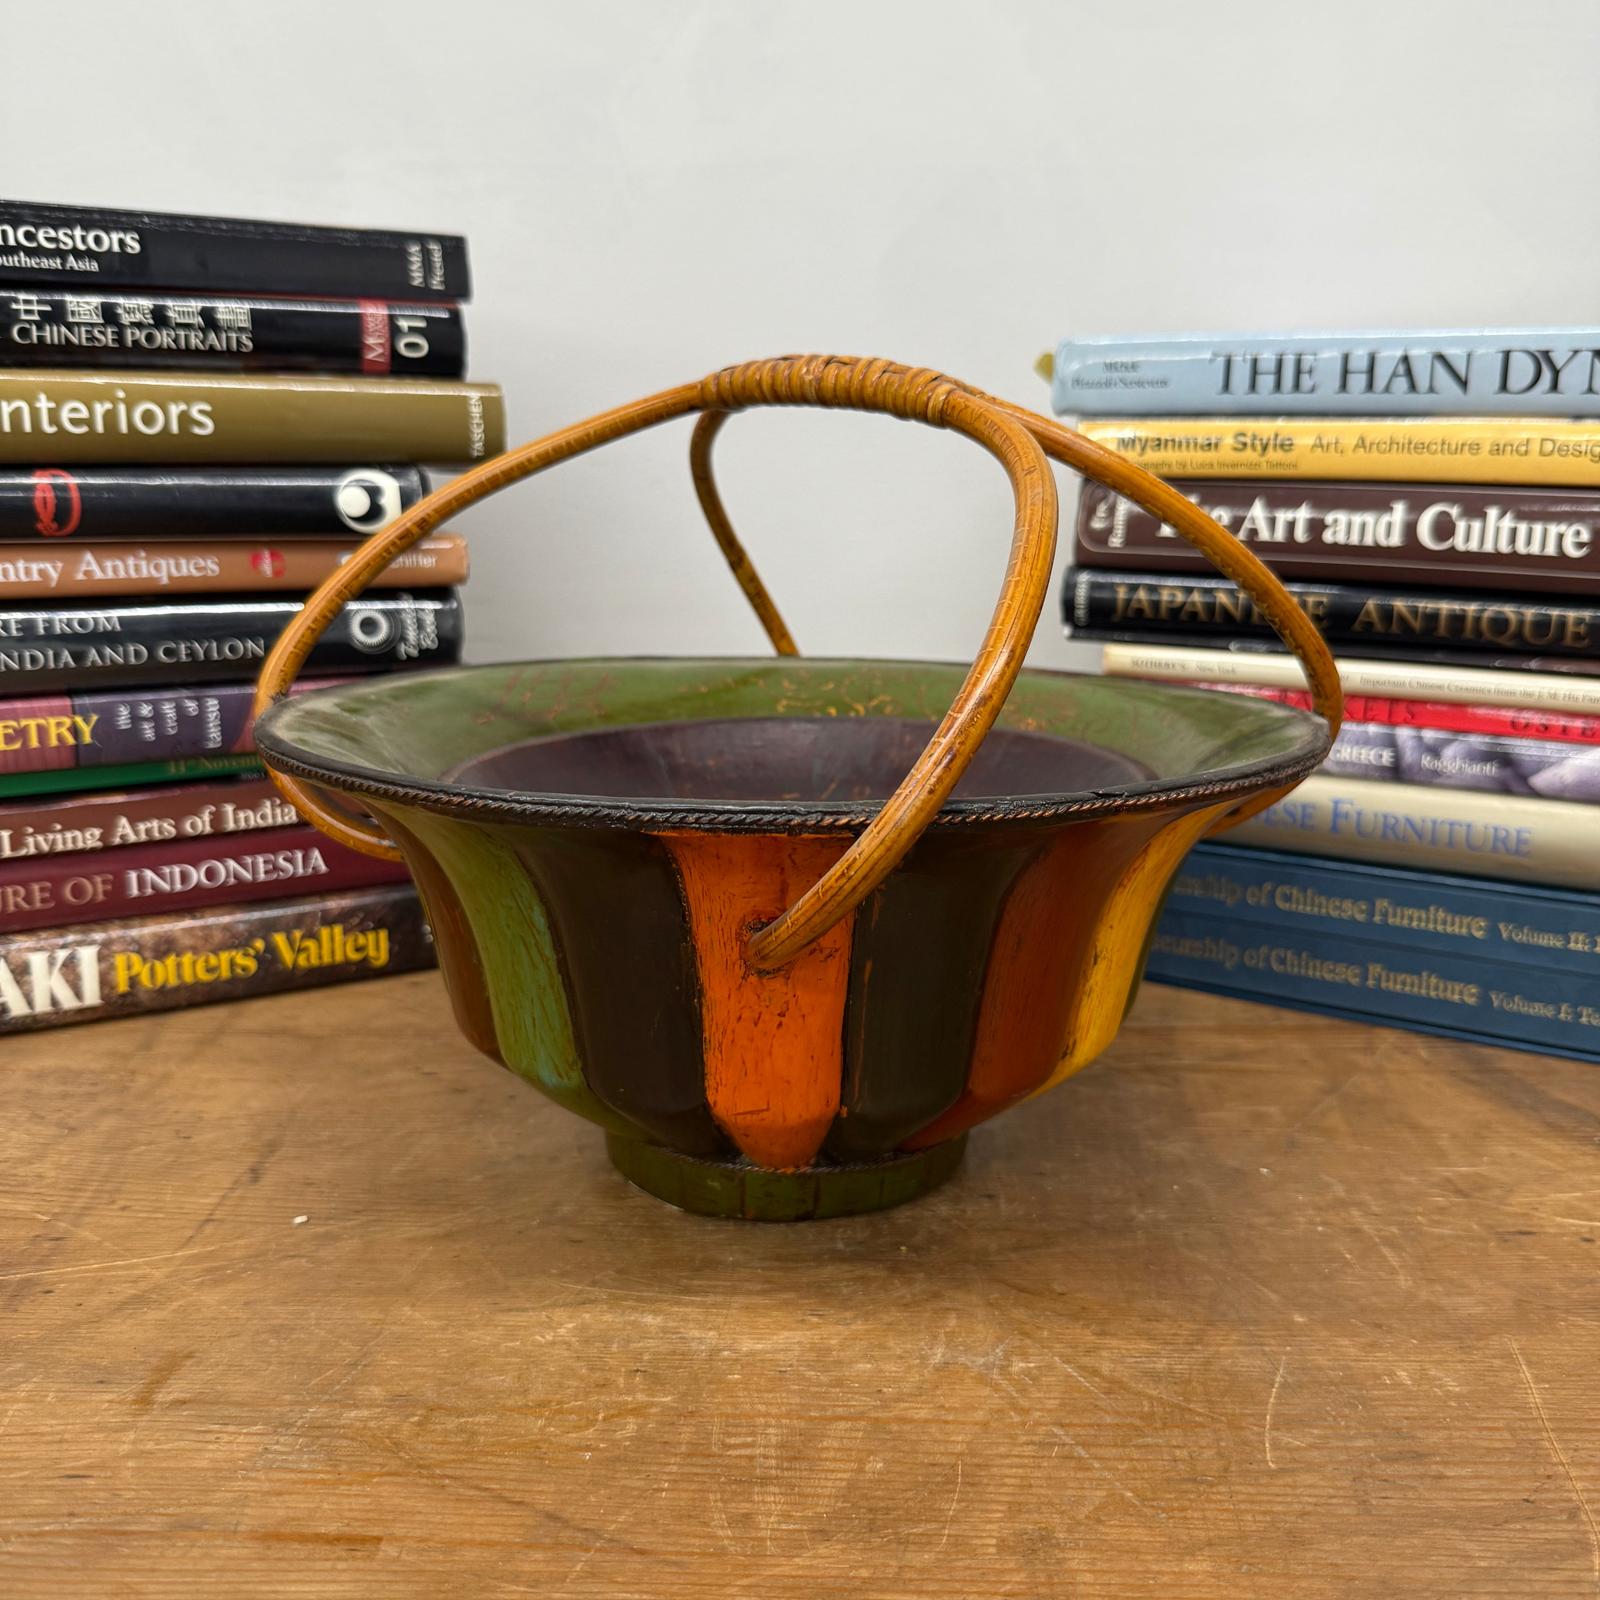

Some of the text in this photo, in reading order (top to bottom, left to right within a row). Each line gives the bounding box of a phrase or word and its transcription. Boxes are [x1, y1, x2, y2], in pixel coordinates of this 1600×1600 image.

[64, 253, 100, 273] Asia
[11, 322, 253, 353] CHINESE PORTRAITS
[393, 313, 430, 359] 01
[1209, 350, 1319, 395] THE
[1334, 349, 1478, 395] HAN
[1, 388, 215, 436] nteriors
[1117, 434, 1223, 457] Myanmar
[1232, 432, 1295, 457] Style
[1310, 436, 1345, 456] Art,
[1353, 435, 1481, 456] Architecture
[1487, 438, 1529, 457] and
[1238, 496, 1313, 543] Art
[1322, 499, 1405, 547] and
[1416, 502, 1592, 559] Culture
[0, 550, 220, 588] ntry Antiques
[33, 614, 121, 636] FROM
[1111, 583, 1330, 630] JAPANE
[1352, 596, 1591, 649] ANTIQUE
[0, 635, 265, 672] NDIA AND CEYLON
[0, 713, 99, 751] ETRY
[0, 797, 299, 858] Living Arts of India
[1327, 797, 1534, 857] FURNITURE
[63, 873, 114, 905] OF
[125, 847, 329, 898] INDONESIA
[1246, 880, 1275, 906] of
[1274, 884, 1369, 923] Chinese
[1372, 897, 1489, 939] Furniture
[1497, 921, 1566, 949] Volume
[113, 938, 266, 995] Potters'
[271, 924, 390, 969] Valley
[1243, 943, 1270, 968] of
[1269, 947, 1362, 987] Chinese
[1364, 960, 1482, 1007] Furniture
[1488, 989, 1556, 1019] Volume
